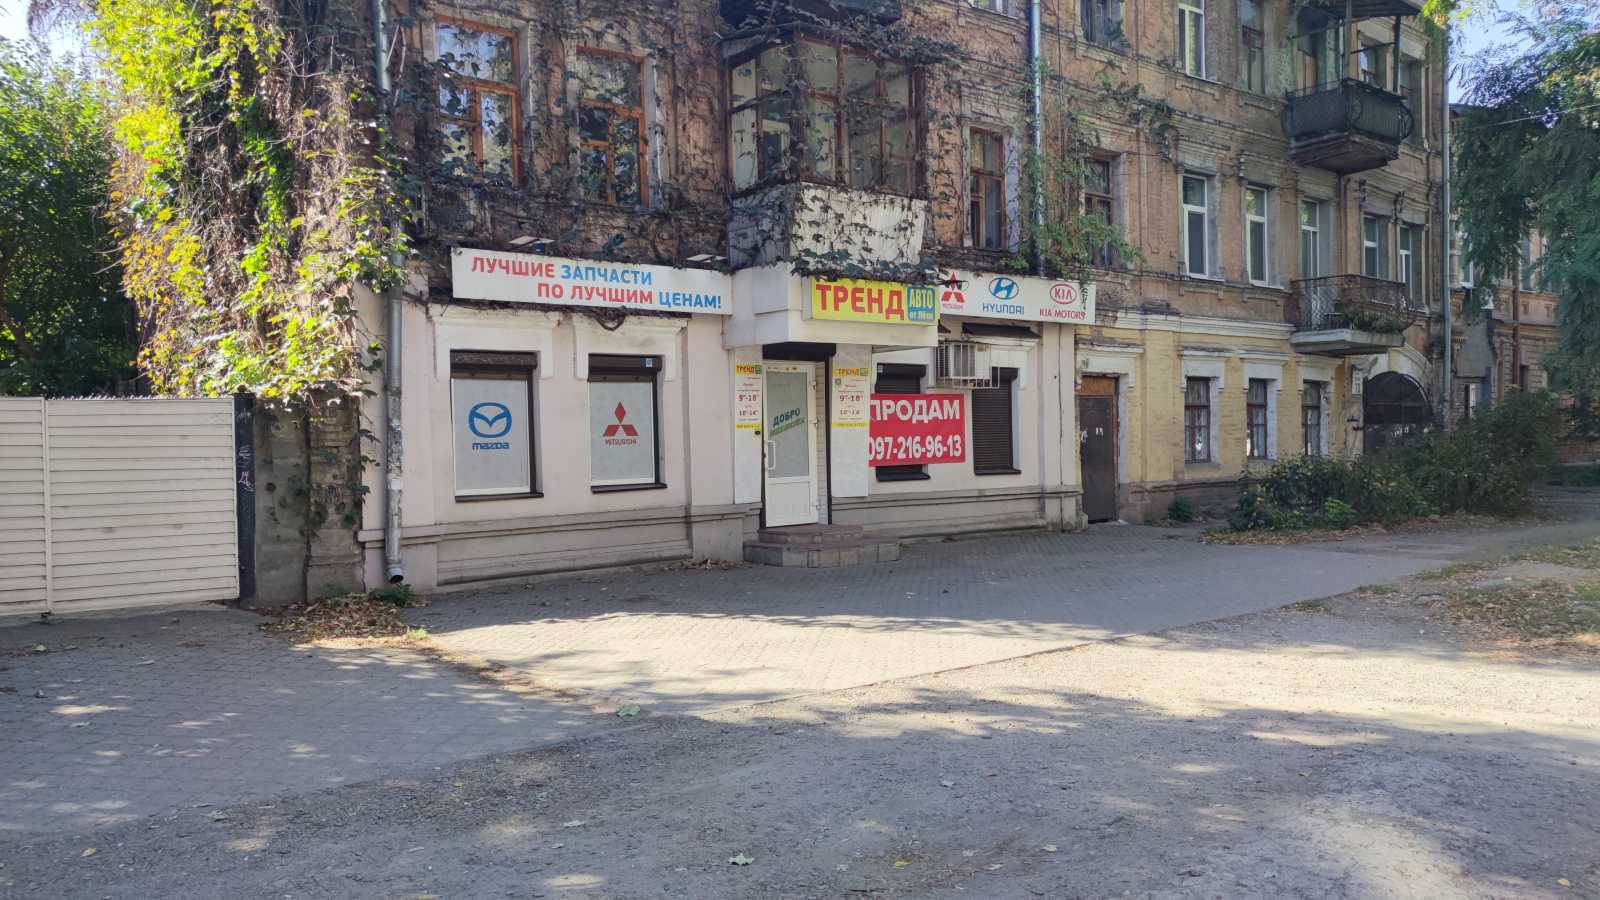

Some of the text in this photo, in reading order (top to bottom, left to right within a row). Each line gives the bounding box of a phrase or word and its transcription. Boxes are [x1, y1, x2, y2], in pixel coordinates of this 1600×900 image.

[471, 256, 652, 285] ЛУЧШИЕ ЗАПЧАСТИ
[537, 283, 722, 309] ПО ЛУЧШИМ ЦЕНАМ!
[816, 284, 905, 321] ТРЕНД
[909, 288, 934, 308] АВТО
[1054, 288, 1073, 300] KIA
[982, 303, 1025, 315] HYUNDAI
[1040, 308, 1052, 316] KIA
[773, 408, 800, 428] ДОБРО
[870, 400, 960, 423] ПРОДАМ
[472, 442, 509, 450] mazda
[867, 435, 962, 460] 097-216-96-13
